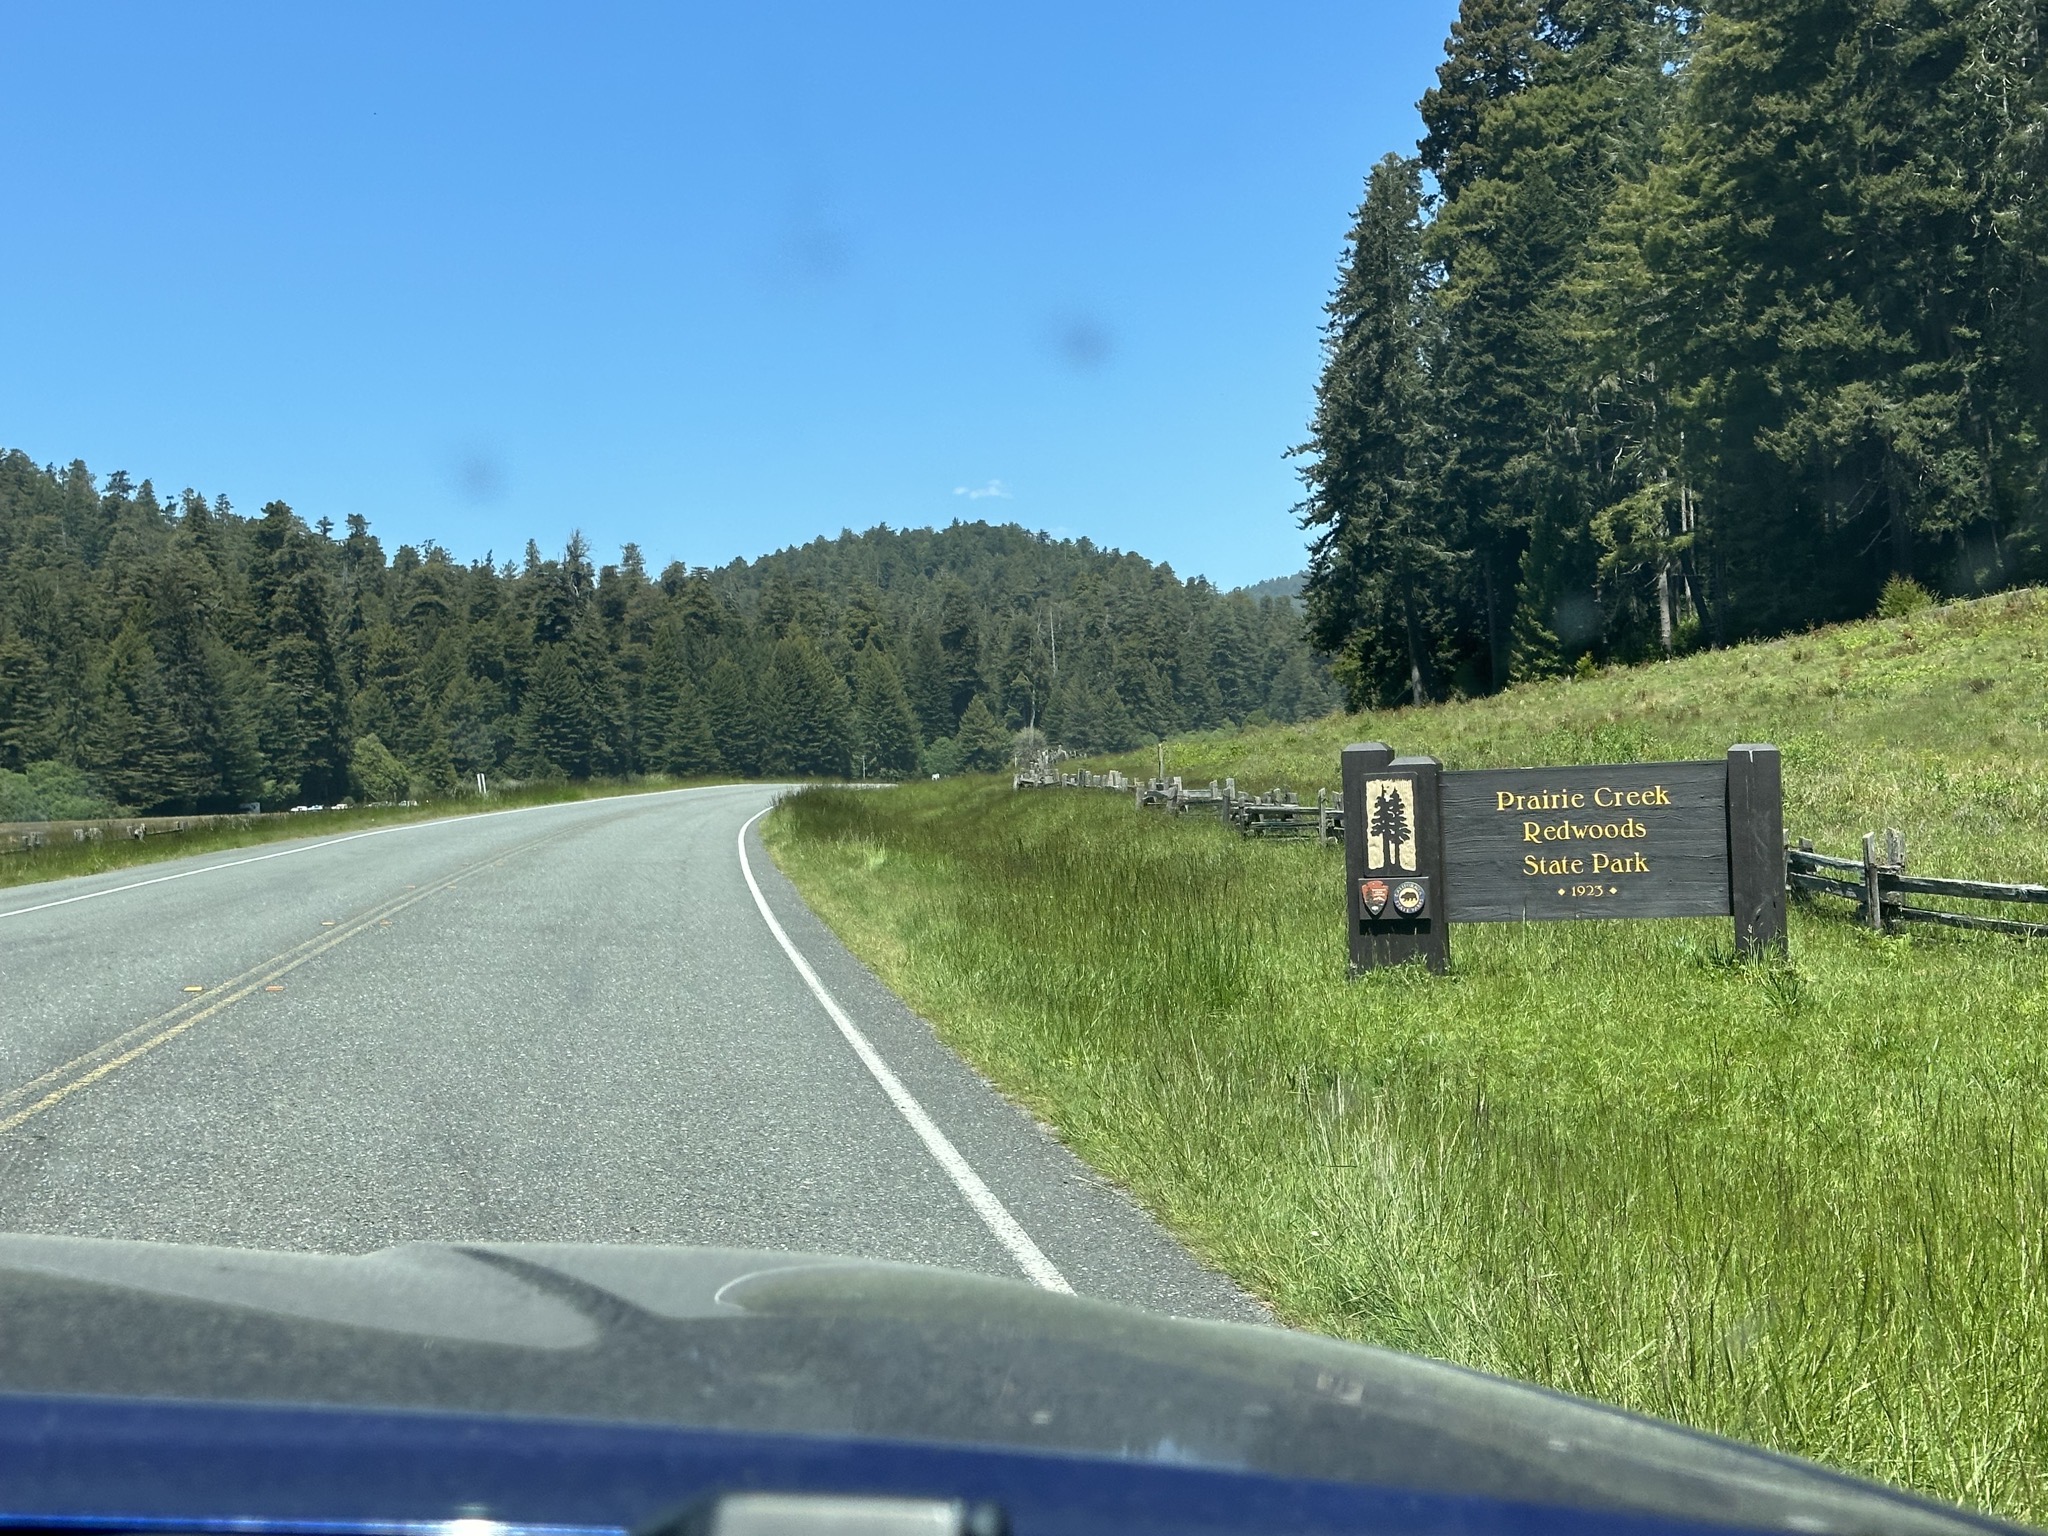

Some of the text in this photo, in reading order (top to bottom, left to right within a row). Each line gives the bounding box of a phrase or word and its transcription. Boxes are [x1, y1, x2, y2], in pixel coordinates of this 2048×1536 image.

[1496, 785, 1671, 811] Prairie Creek
[1522, 818, 1647, 843] Redwoods
[1522, 852, 1650, 876] State Park
[1571, 885, 1604, 897] 1923
